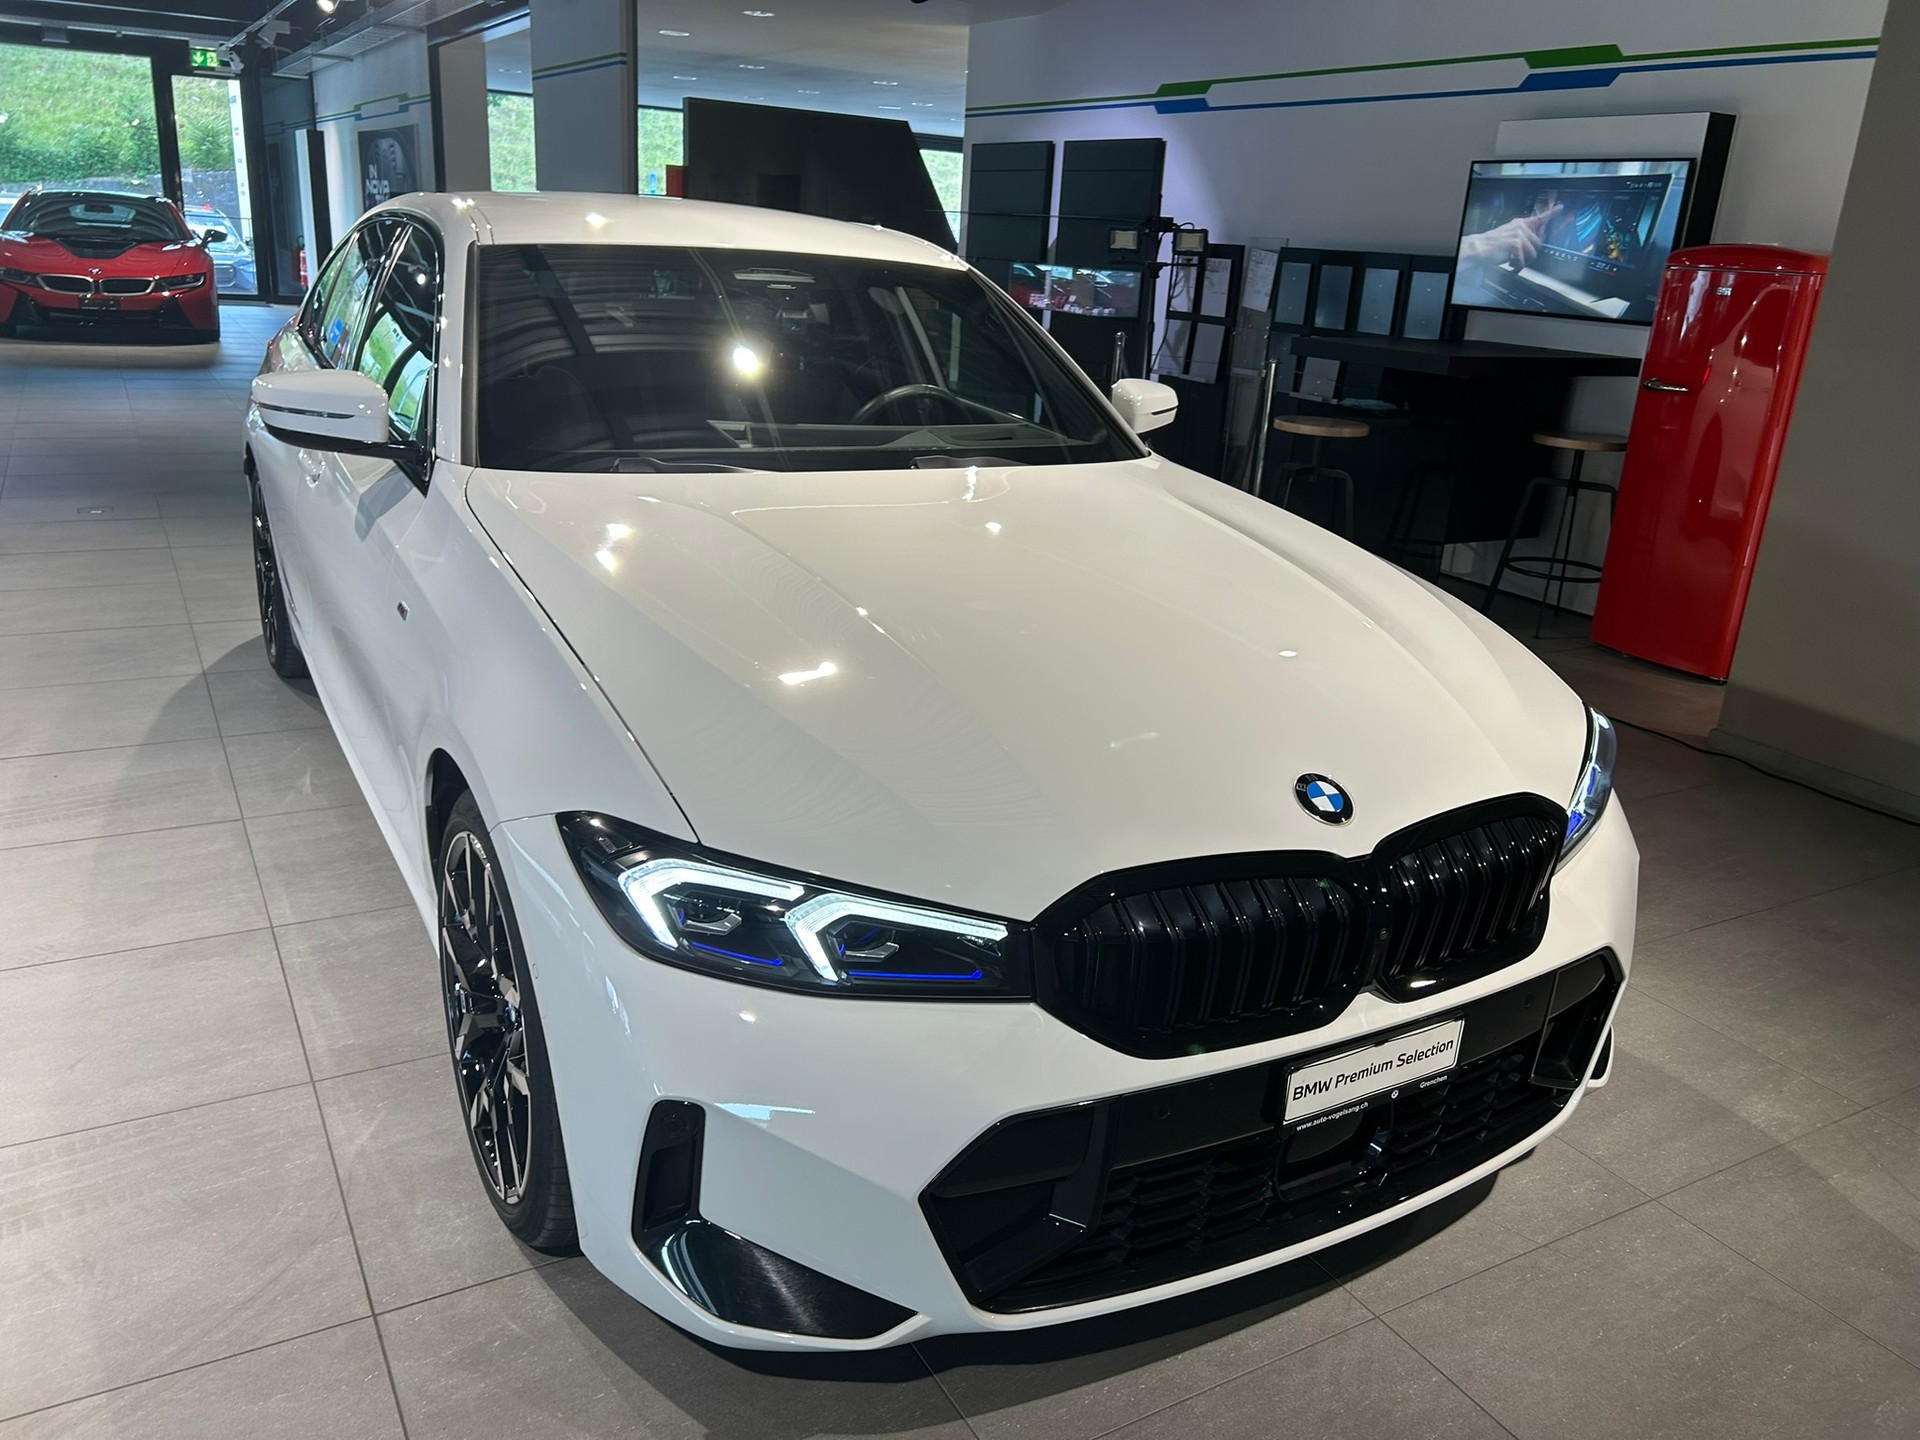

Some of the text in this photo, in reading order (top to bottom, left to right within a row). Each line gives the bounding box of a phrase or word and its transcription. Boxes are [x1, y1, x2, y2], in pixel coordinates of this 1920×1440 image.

[1292, 1039, 1454, 1101] BMW Premium Selection
[1296, 1075, 1448, 1132] www.auto-vogelsang.ch Grenchen
